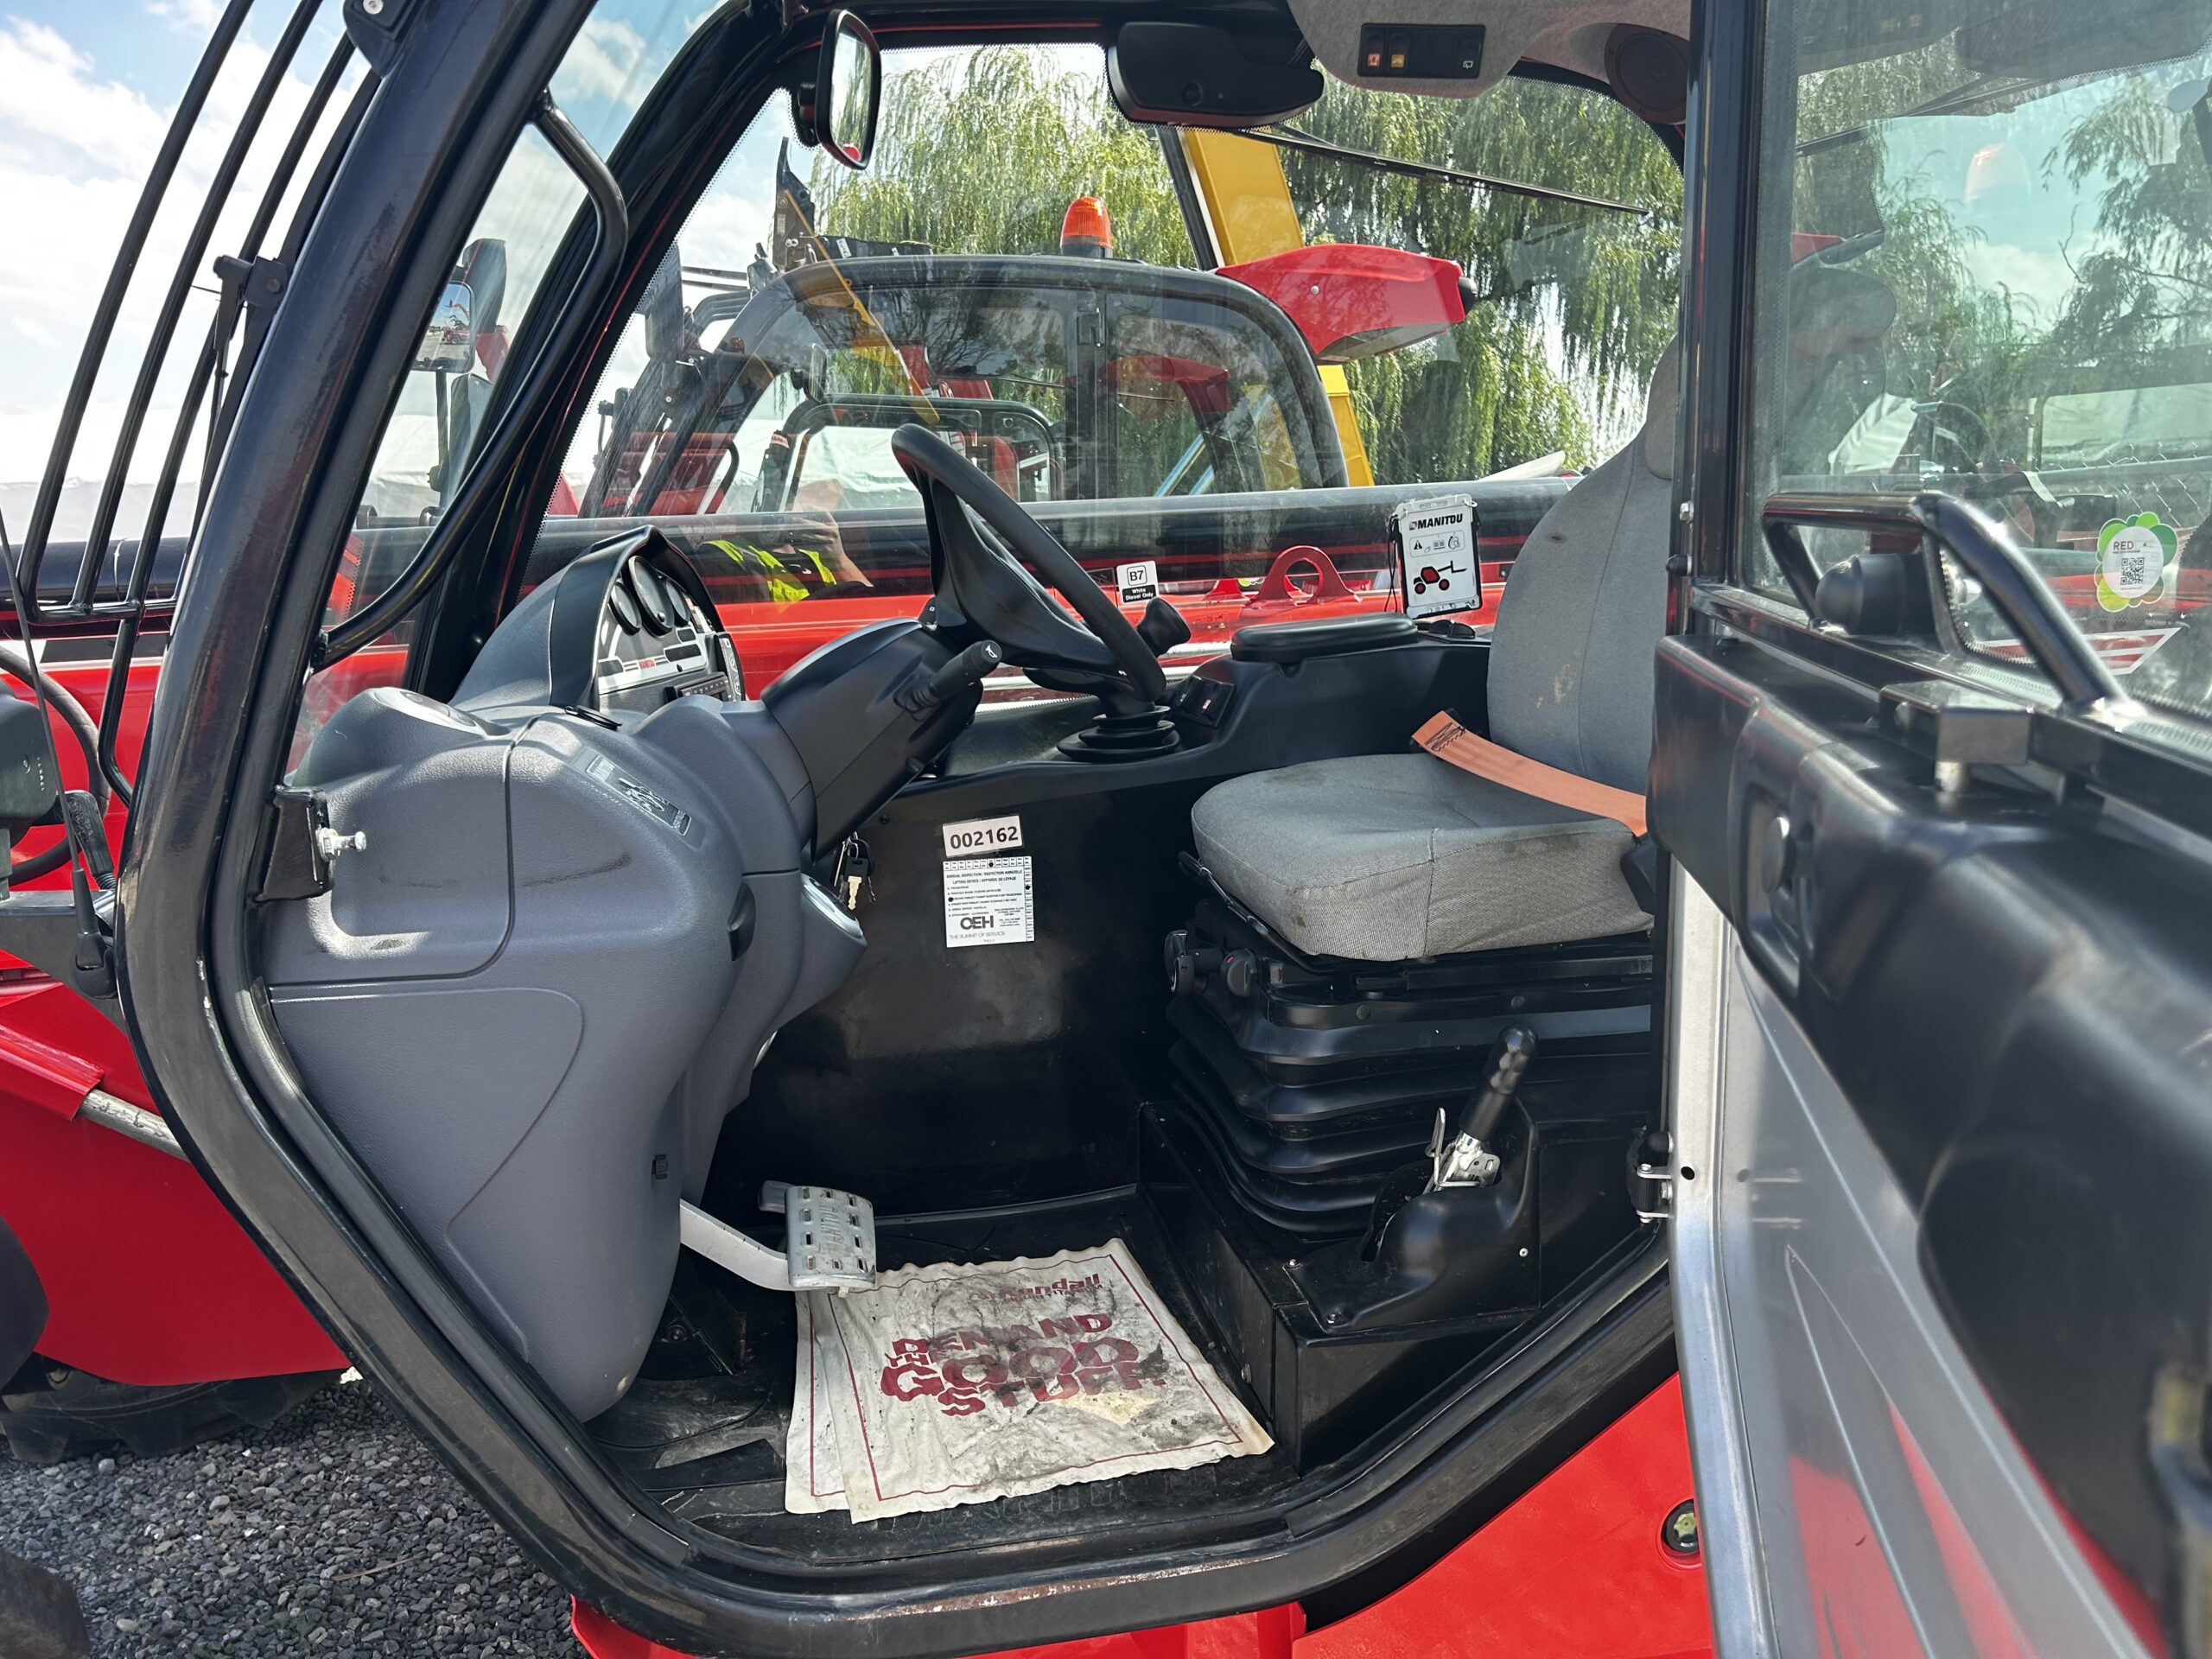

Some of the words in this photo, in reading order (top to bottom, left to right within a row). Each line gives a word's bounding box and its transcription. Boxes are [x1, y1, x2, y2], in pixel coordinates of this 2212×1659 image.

[1417, 513, 1464, 530] MANITOU
[2113, 541, 2134, 550] RED
[1129, 570, 1144, 581] B7
[950, 826, 1019, 849] 002162
[892, 1313, 1112, 1357] DEMAND
[884, 1350, 942, 1368] THE
[880, 1337, 1140, 1402] GOOD
